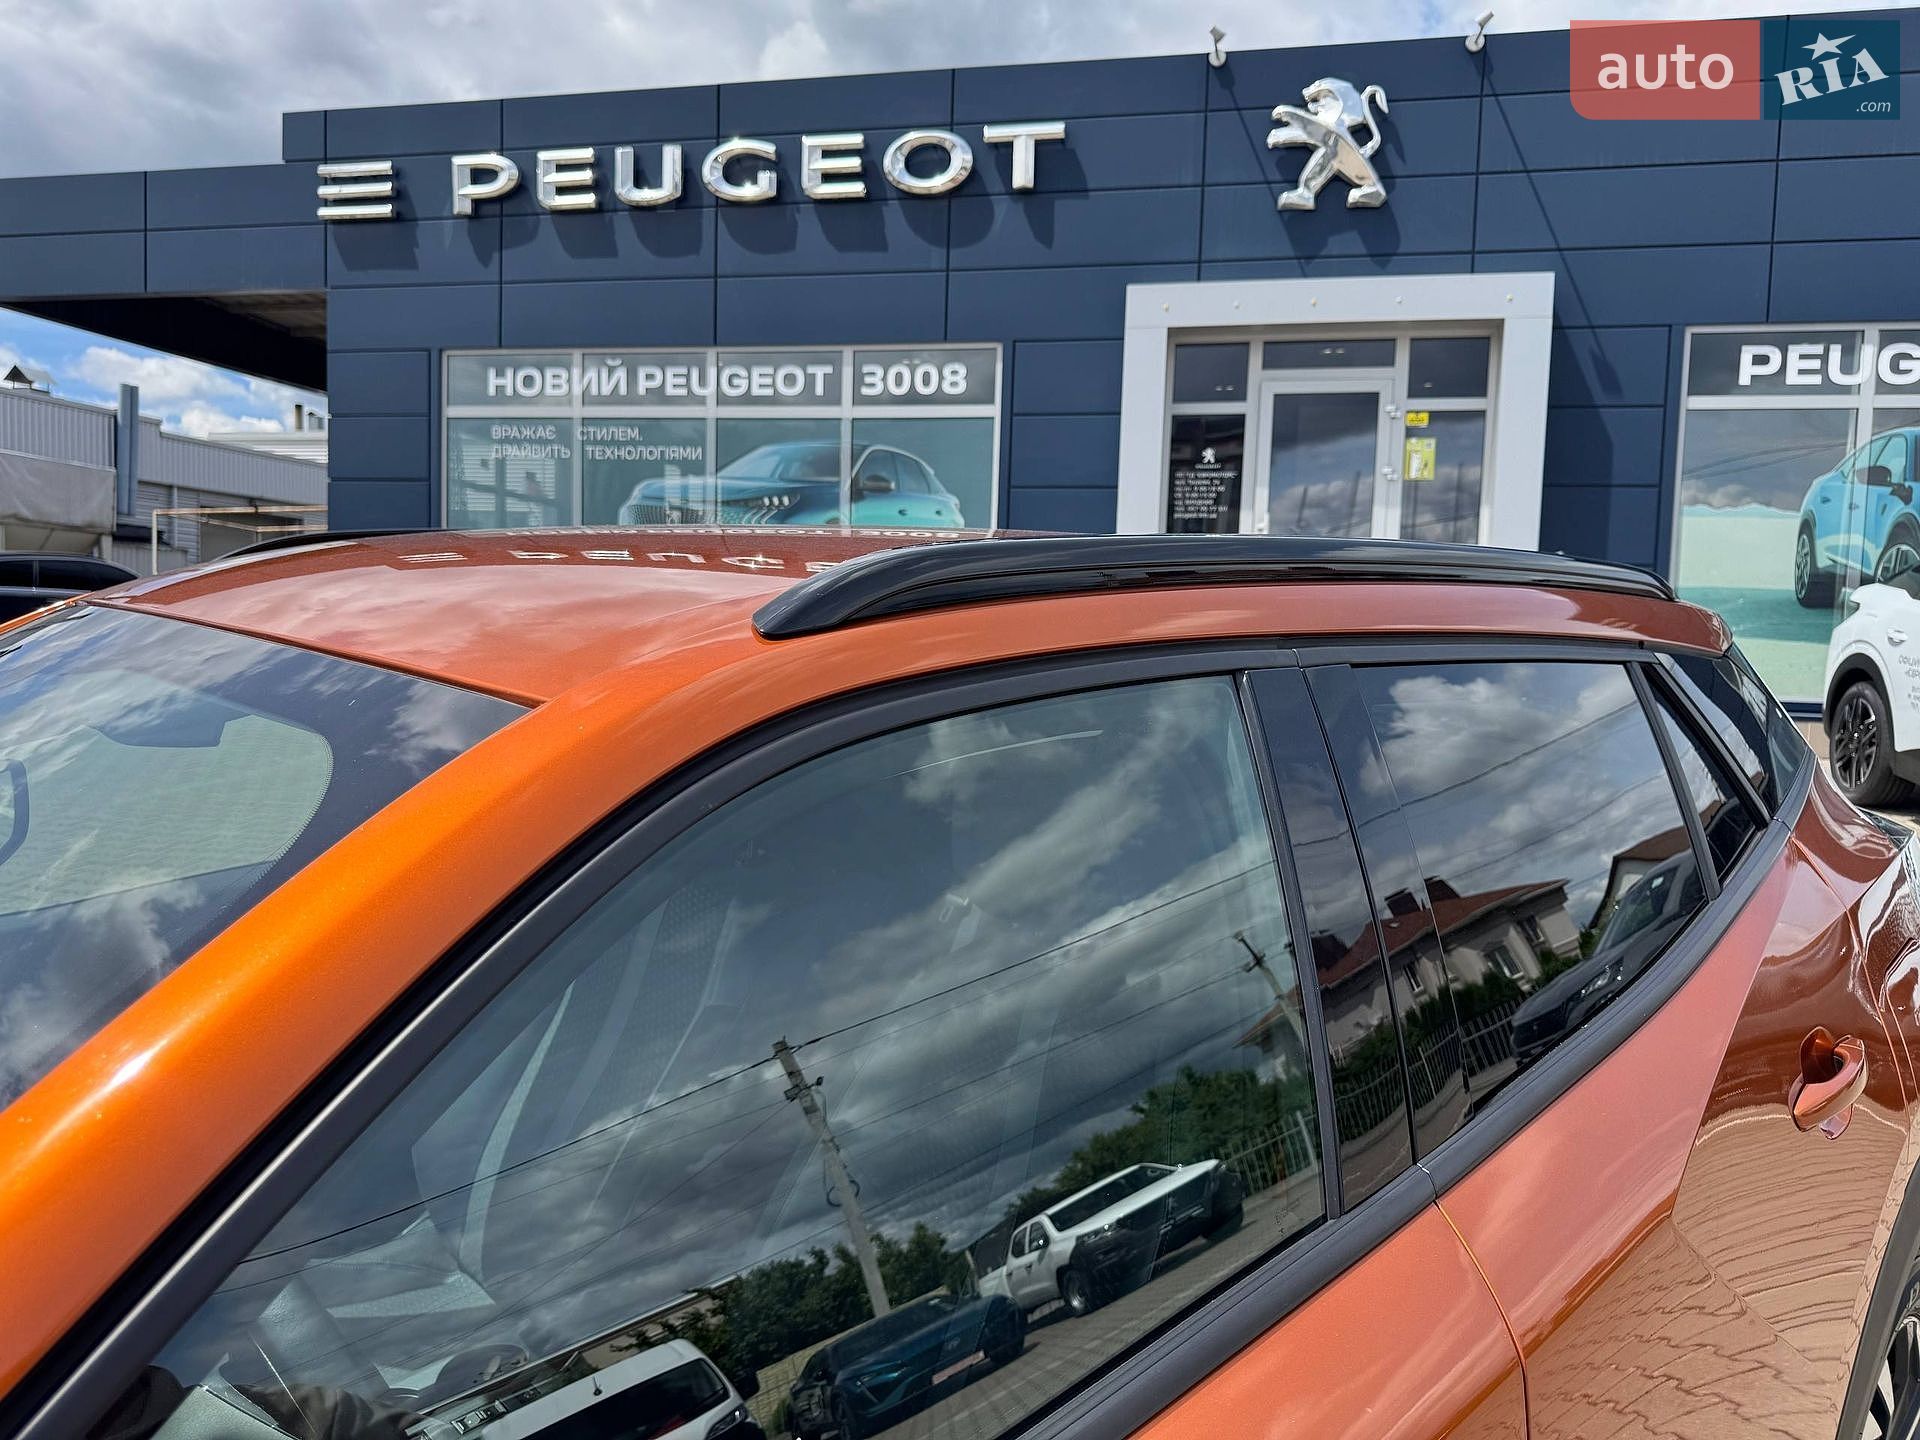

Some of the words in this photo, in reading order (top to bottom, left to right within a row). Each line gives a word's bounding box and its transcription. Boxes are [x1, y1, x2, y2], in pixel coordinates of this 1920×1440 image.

[451, 121, 1066, 217] PEUGEOT
[487, 357, 628, 397] НОВИЙ
[637, 363, 834, 398] PEUGEOT
[860, 362, 968, 397] 3008
[1738, 342, 1920, 386] PEUG
[491, 424, 557, 440] ВРАЖАЄ
[585, 444, 704, 461] ТЕХНОЛОГІЯМИ
